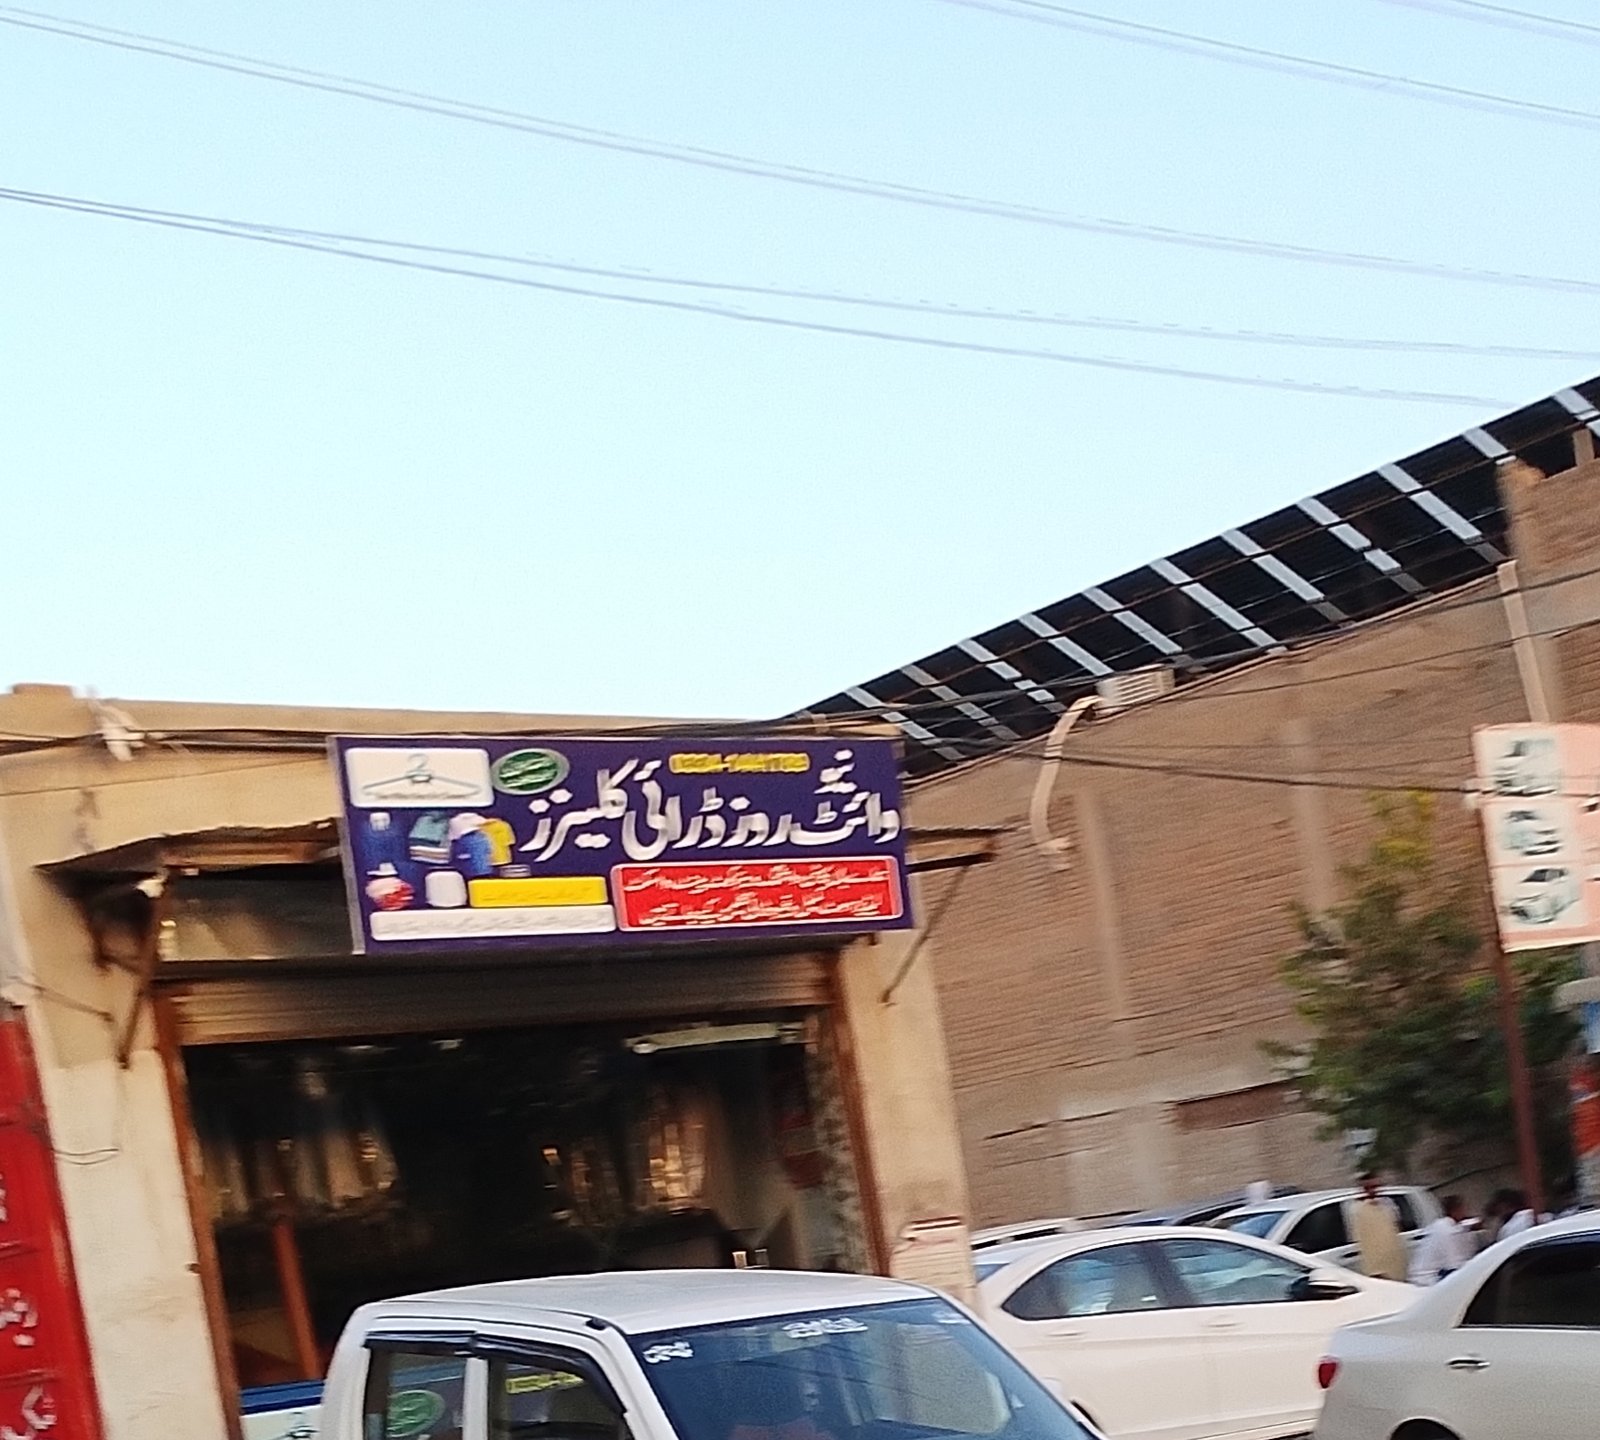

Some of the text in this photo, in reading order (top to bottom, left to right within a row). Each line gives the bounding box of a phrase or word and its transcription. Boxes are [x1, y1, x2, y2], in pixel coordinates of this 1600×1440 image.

[517, 758, 640, 863] کلینرز
[621, 759, 727, 862] ڈرائی
[720, 796, 793, 848] روز
[789, 790, 899, 847] وائٹ
